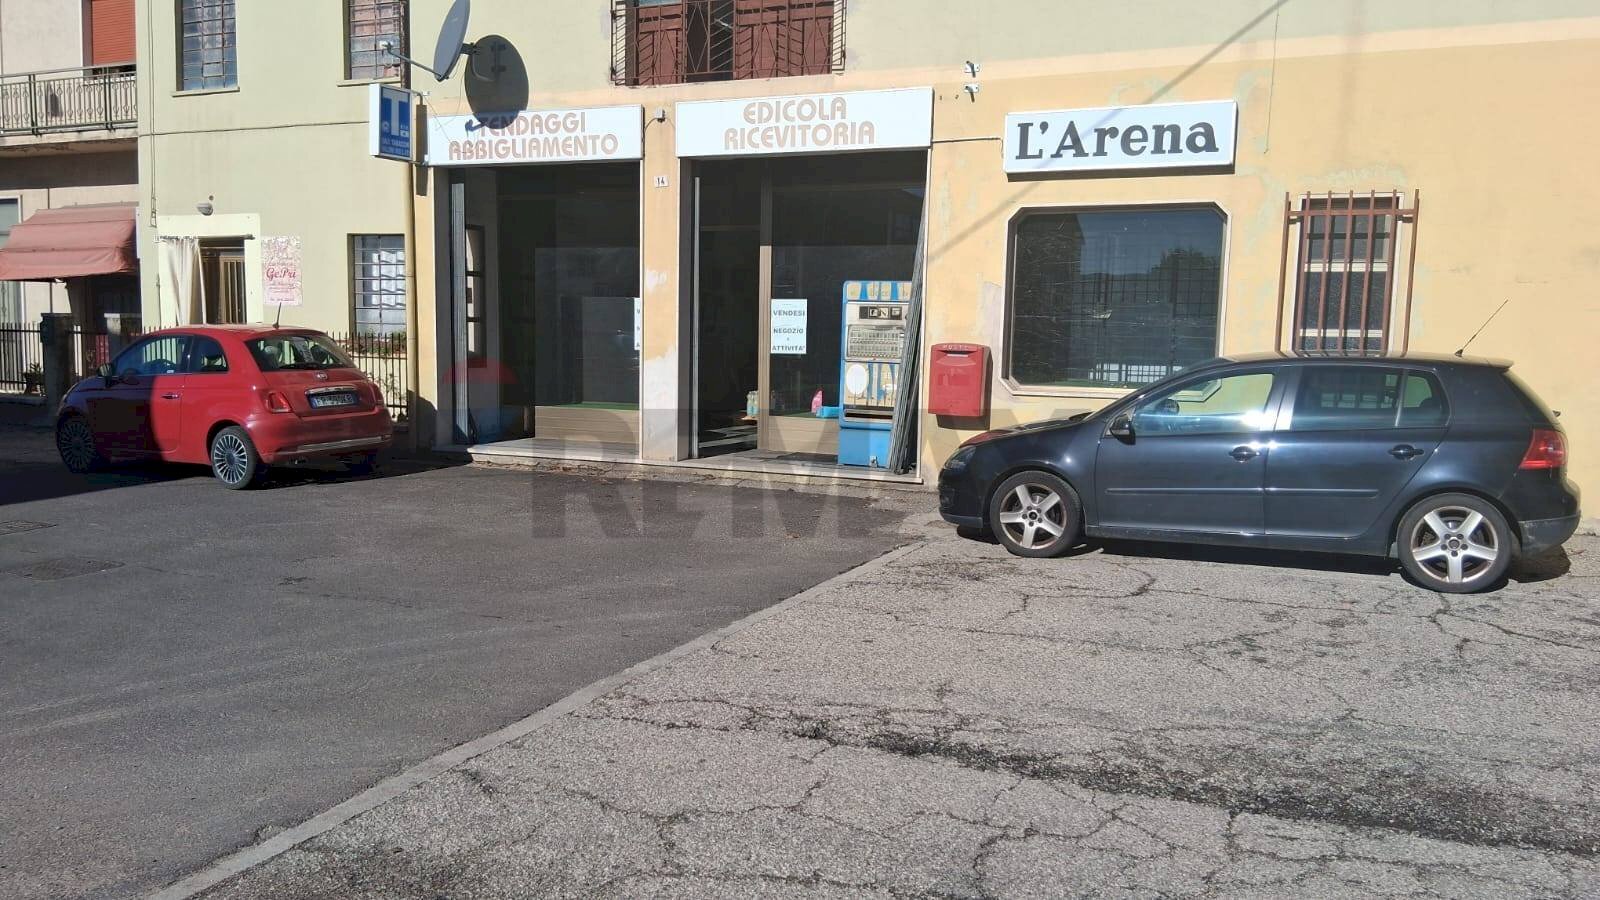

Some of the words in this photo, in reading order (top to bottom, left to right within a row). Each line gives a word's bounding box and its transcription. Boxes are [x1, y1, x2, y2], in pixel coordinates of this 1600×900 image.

[382, 87, 409, 137] T
[742, 96, 847, 124] EDICOLA
[480, 111, 586, 137] TENDAGGI
[724, 121, 876, 151] RICEVITORIA
[448, 133, 619, 160] ABBIGLIAMENTO
[1015, 120, 1219, 160] L'Arena
[656, 176, 666, 185] 14
[772, 309, 806, 317] VENDESI
